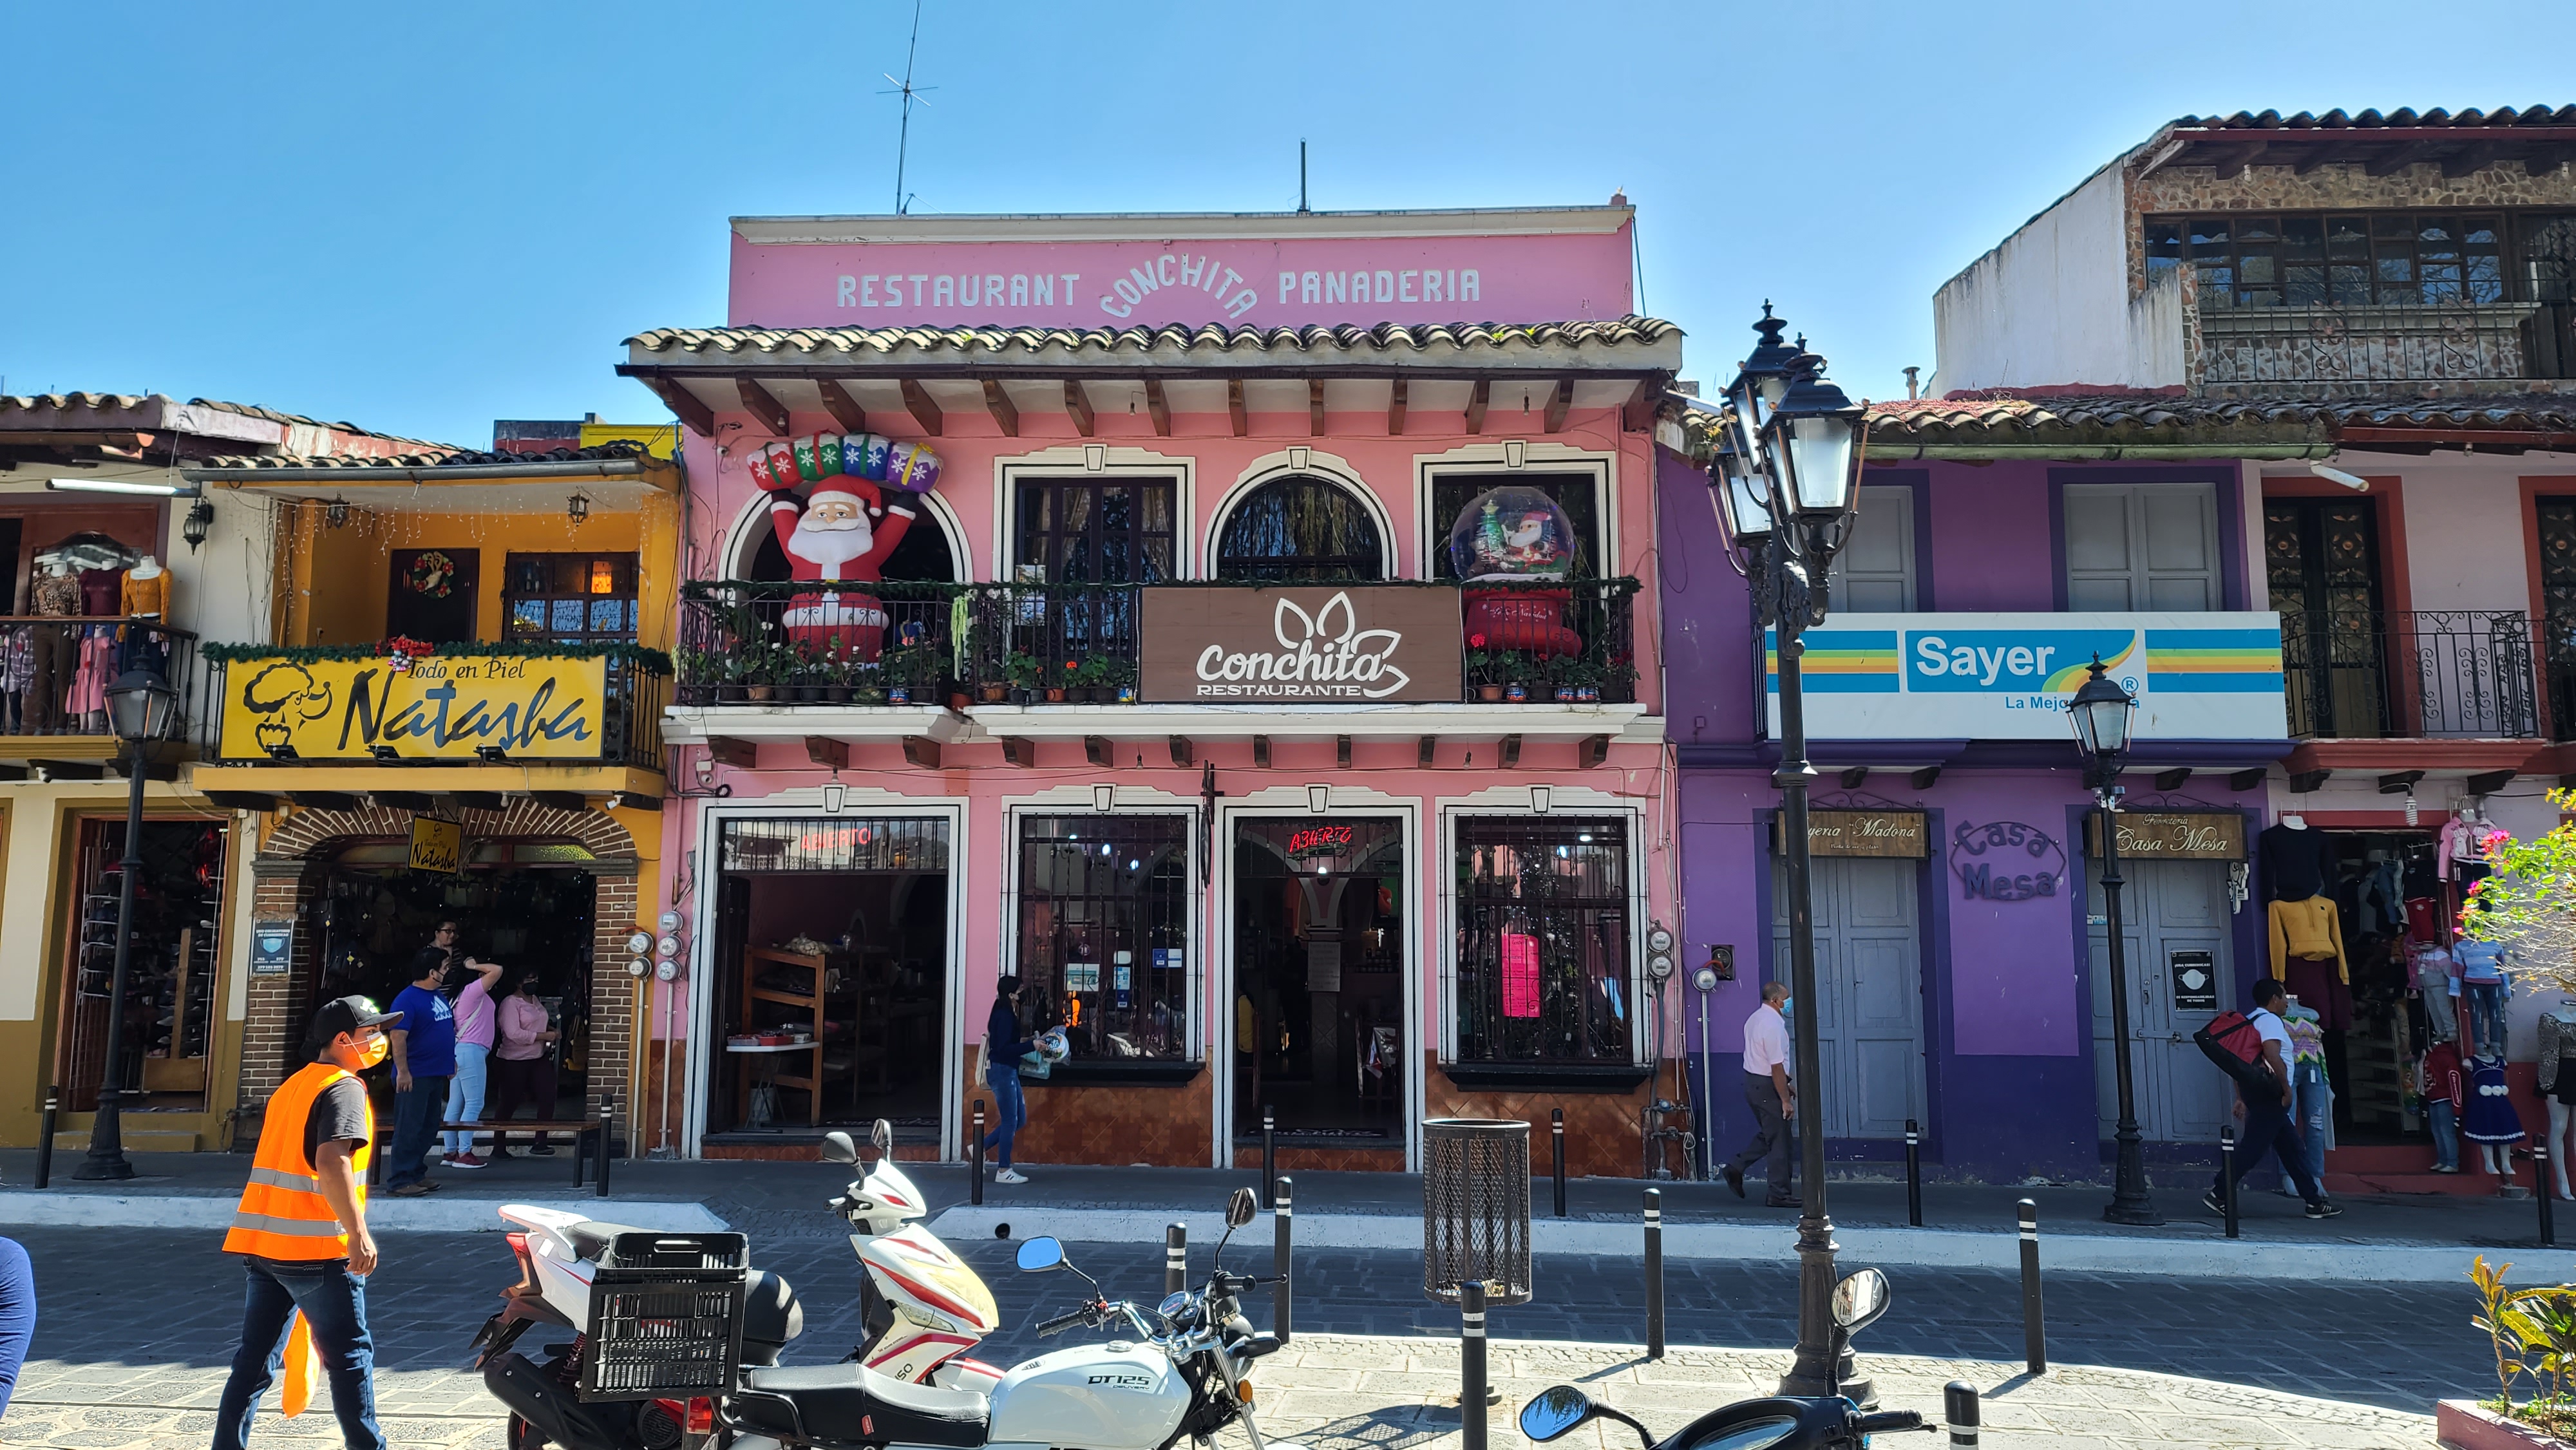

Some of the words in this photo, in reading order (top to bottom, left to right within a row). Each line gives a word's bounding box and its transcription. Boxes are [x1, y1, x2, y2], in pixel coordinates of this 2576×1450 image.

[837, 274, 1079, 308] RESTAURANT
[1100, 254, 1258, 319] CONCHITA
[1279, 269, 1479, 305] PANADERIA
[406, 659, 448, 679] Todo
[456, 664, 478, 679] en
[484, 659, 526, 679] Piel
[1196, 639, 1386, 681] Conchita
[1915, 637, 2056, 686] Sayer
[1196, 685, 1361, 697] RESTAURANTE
[2005, 697, 2024, 709] La
[2143, 813, 2189, 825] Ferretería
[801, 827, 871, 851] ABIERTO
[1289, 827, 1352, 852] ABIERTO
[1955, 820, 2050, 858] Casa
[2116, 825, 2164, 851] Casa
[2170, 825, 2228, 852] Mesa
[1963, 862, 2056, 899] Mesa
[1088, 1375, 1151, 1385] DT125
